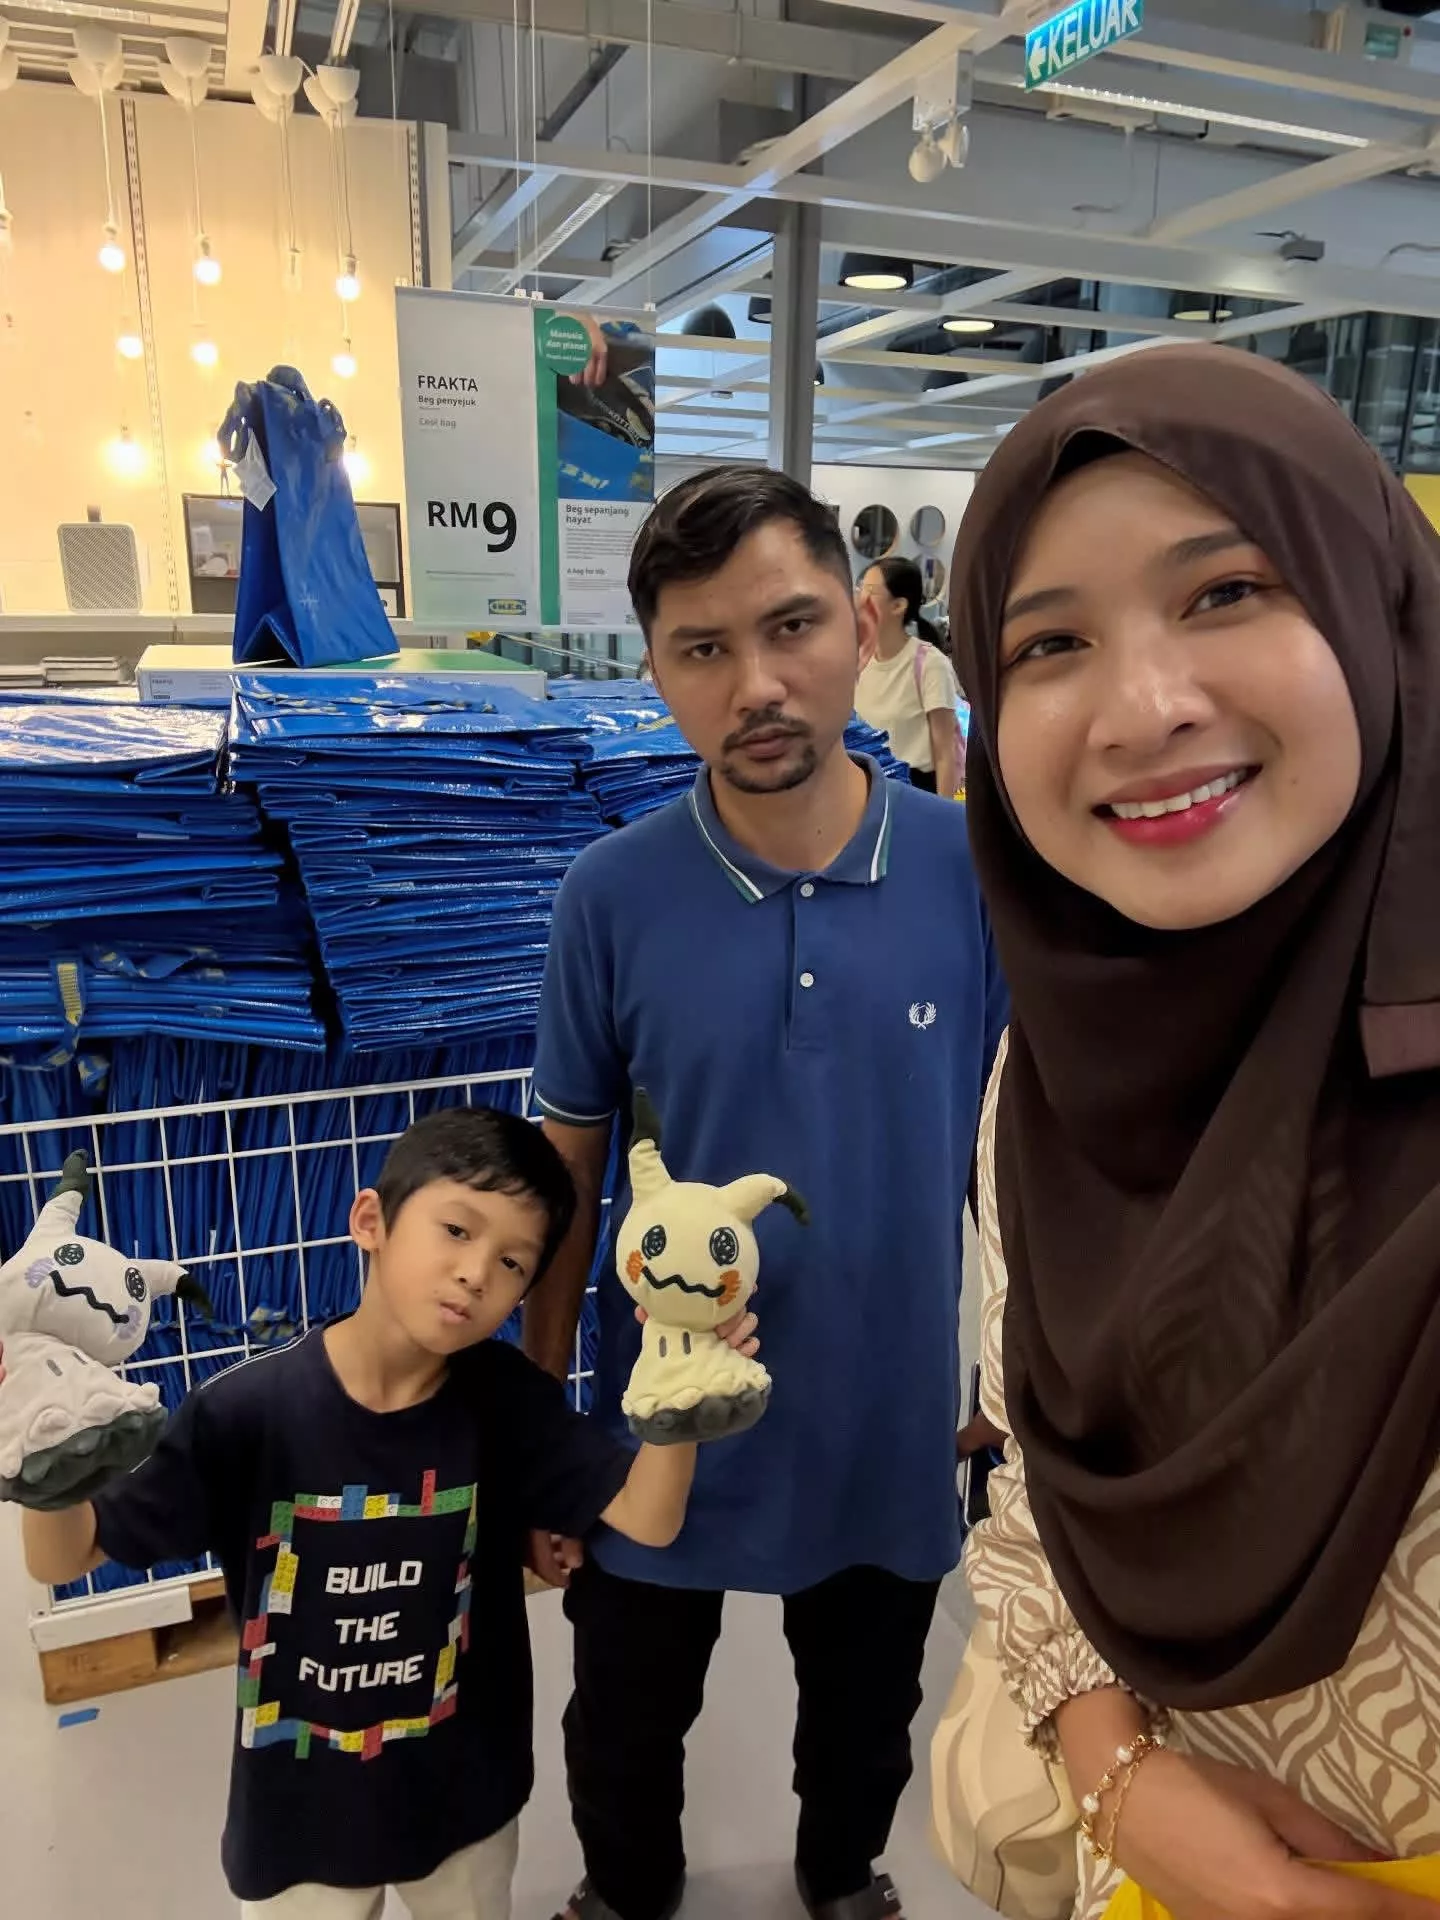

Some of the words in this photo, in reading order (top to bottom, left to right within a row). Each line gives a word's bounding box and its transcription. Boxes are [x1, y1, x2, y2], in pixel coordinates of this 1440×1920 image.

[1048, 0, 1138, 75] KELUAR
[417, 374, 479, 392] FRAKTA
[418, 395, 435, 405] Beg
[436, 397, 476, 407] penyejuk
[566, 504, 583, 515] Beg
[585, 506, 629, 518] sepanjang
[325, 1560, 423, 1594] BUILD
[334, 1611, 400, 1644] THE
[298, 1655, 425, 1692] FUTURE
